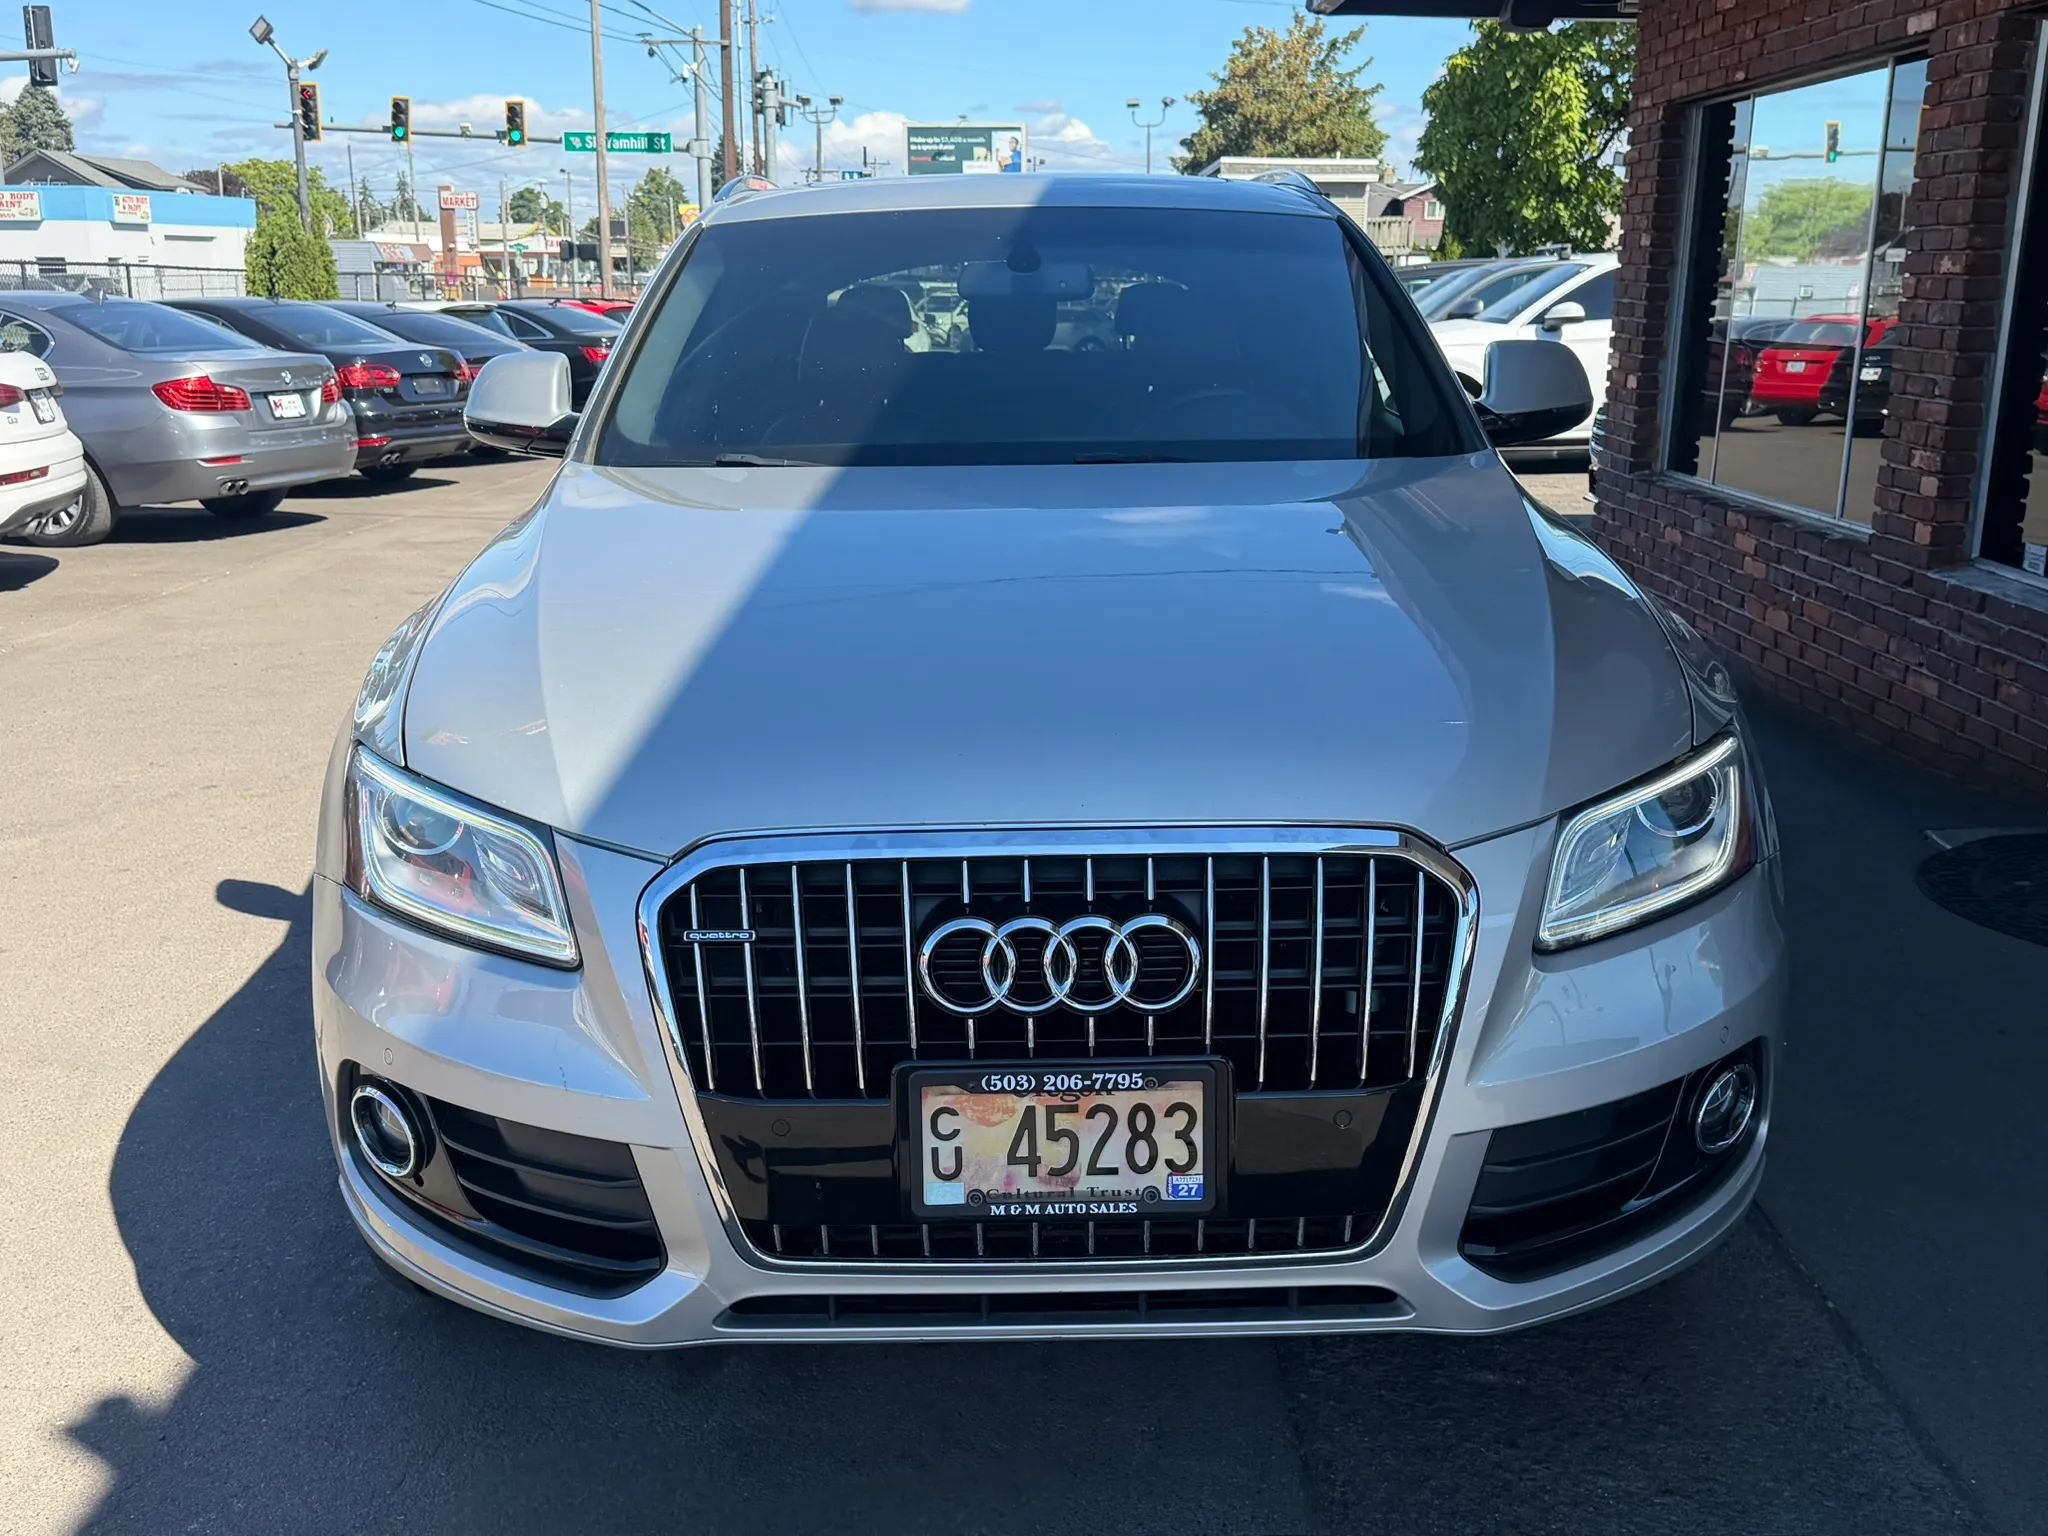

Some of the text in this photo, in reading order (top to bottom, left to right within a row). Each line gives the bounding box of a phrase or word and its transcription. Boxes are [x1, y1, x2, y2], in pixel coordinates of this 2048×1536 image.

[606, 136, 648, 149] Yamhill
[653, 136, 667, 149] St
[442, 196, 475, 207] MARKET
[689, 932, 750, 940] quattro
[981, 1073, 1143, 1091] (503) 206-7795
[1007, 1101, 1198, 1178] 45283
[1087, 1186, 1143, 1198] Trust
[1178, 1184, 1199, 1196] 27
[990, 1202, 1138, 1216] M & M AUTO SALES
